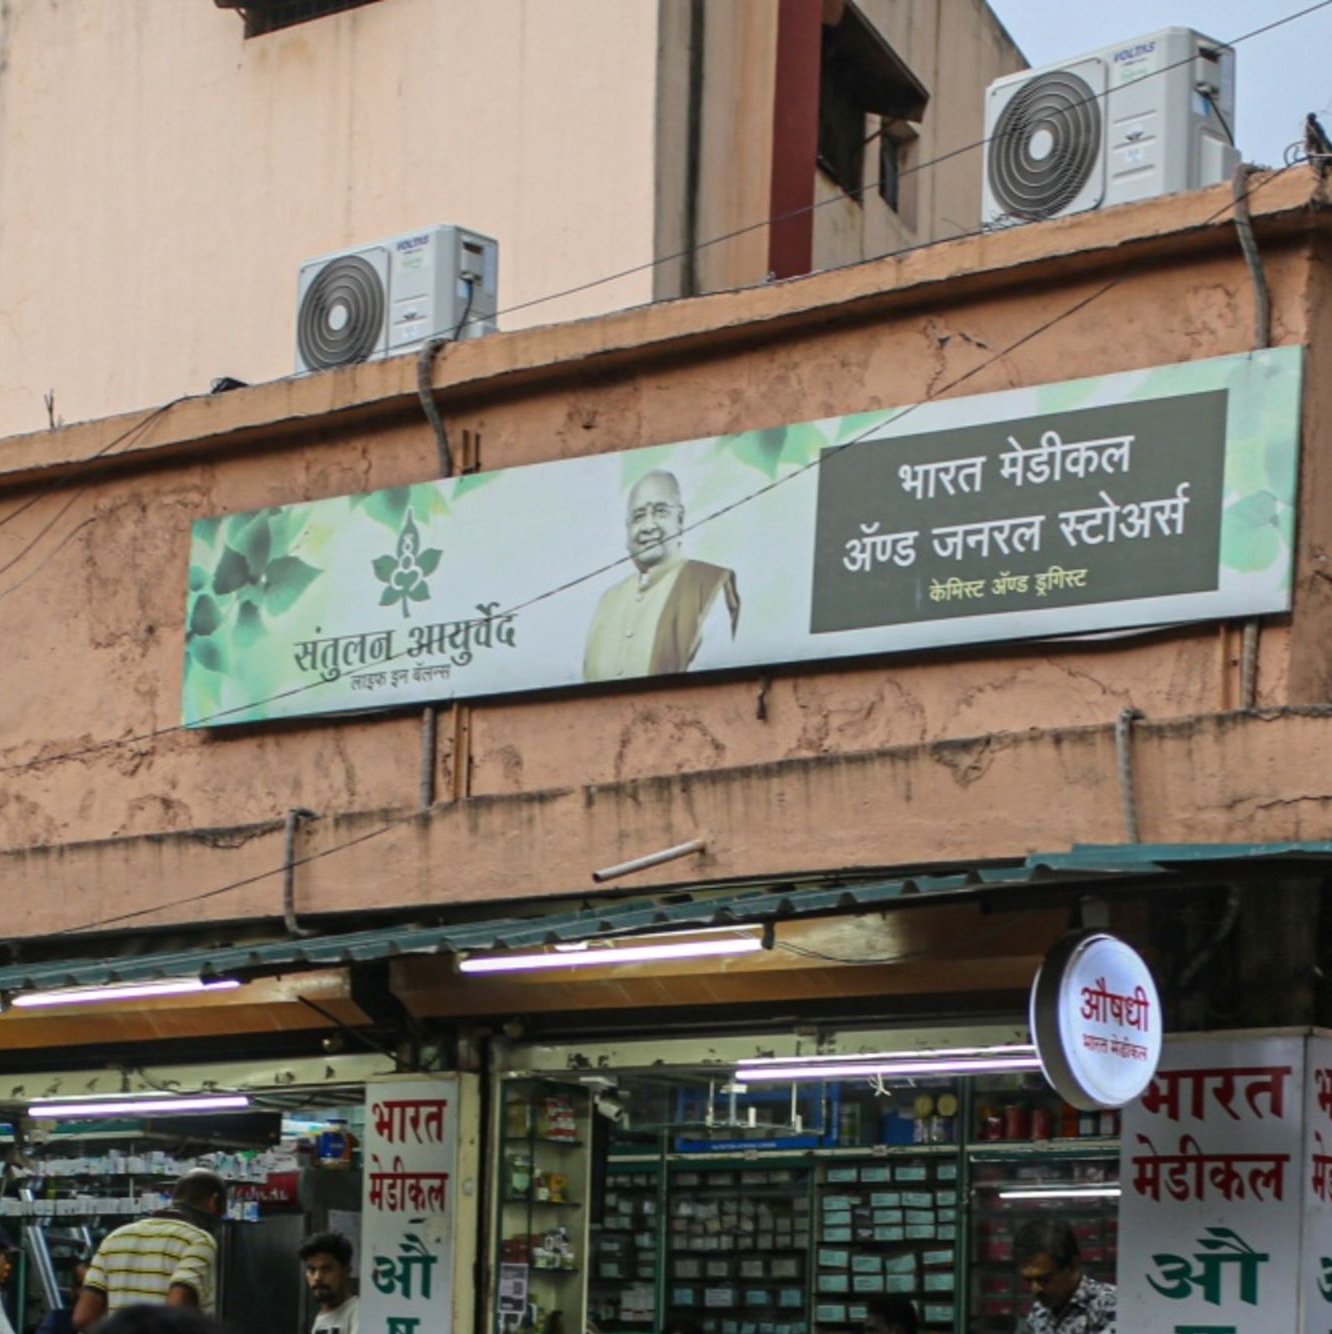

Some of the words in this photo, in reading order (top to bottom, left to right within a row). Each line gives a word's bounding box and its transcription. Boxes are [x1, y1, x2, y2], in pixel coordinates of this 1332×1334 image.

[898, 455, 988, 500] भारत
[999, 431, 1136, 487] मेडीकल
[931, 515, 1046, 562] जनरल
[1058, 482, 1190, 548] स्टोअर्स
[928, 578, 986, 602] केमिस्ट
[293, 626, 396, 683] संतुलन
[406, 602, 519, 666] आयुर्वेद
[350, 671, 387, 691] लाइफ
[390, 669, 409, 688] इन
[1080, 977, 1150, 1032] औषधी
[1083, 1033, 1108, 1053] भारत
[1111, 1033, 1148, 1060] मेडीकल
[373, 1099, 448, 1144] भारत
[1143, 1065, 1292, 1123] भारत
[369, 1154, 449, 1213] मेडीकल
[1132, 1134, 1290, 1202] मेडीकल
